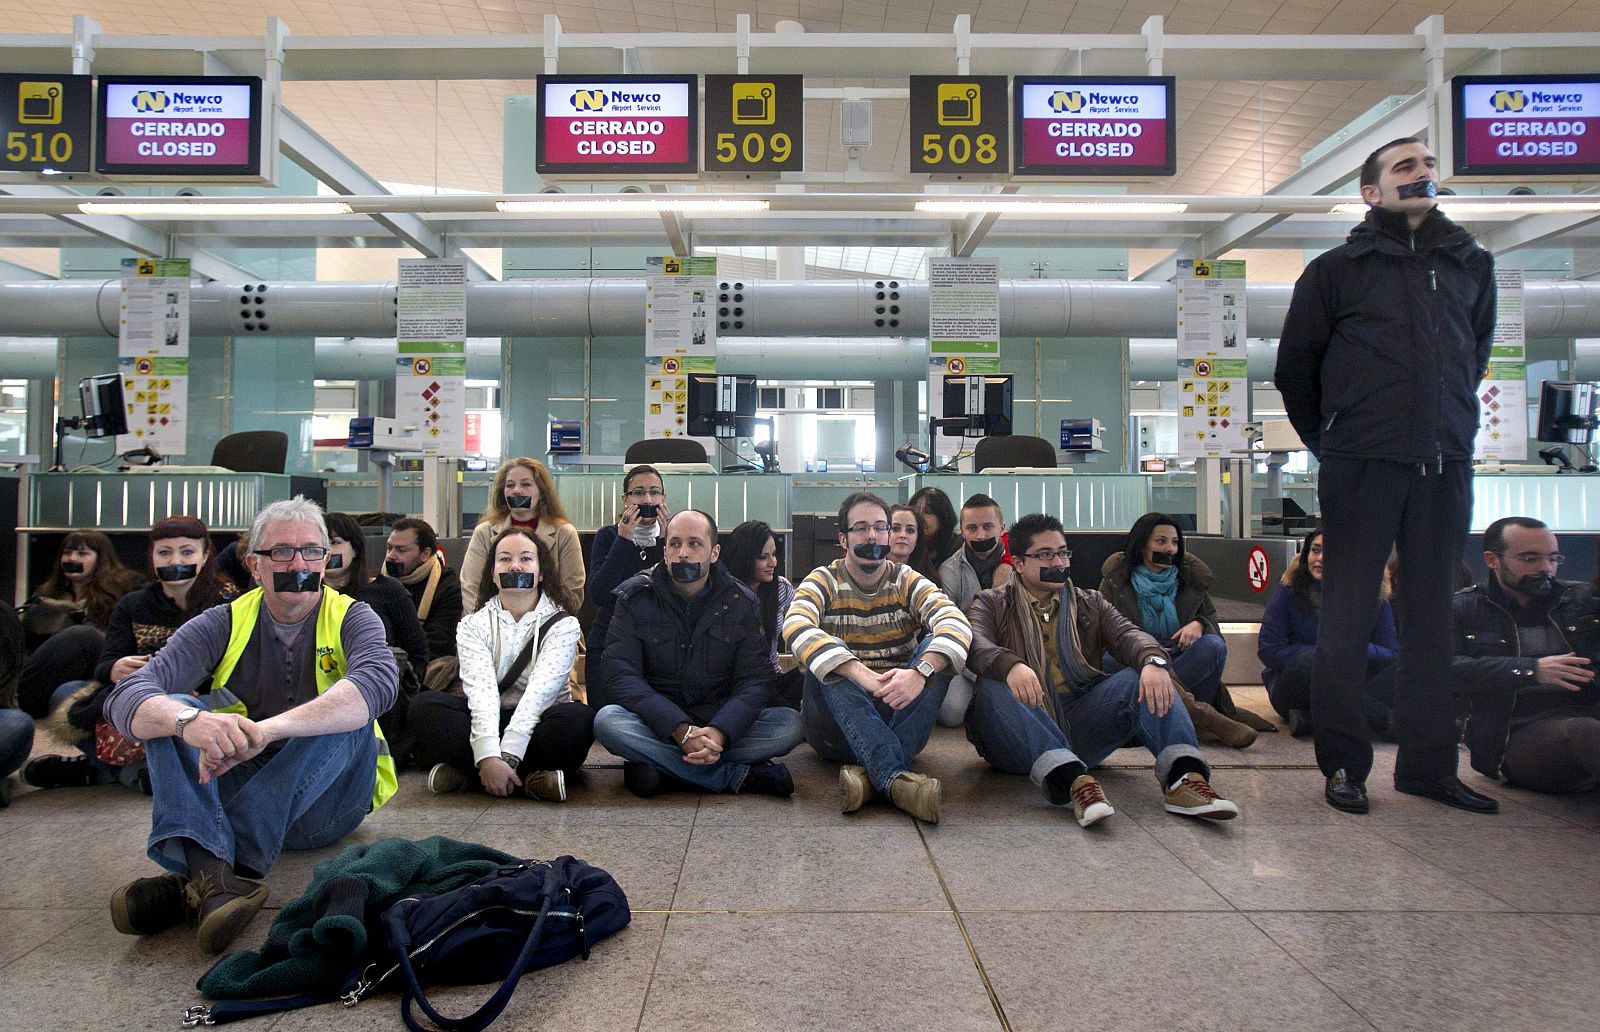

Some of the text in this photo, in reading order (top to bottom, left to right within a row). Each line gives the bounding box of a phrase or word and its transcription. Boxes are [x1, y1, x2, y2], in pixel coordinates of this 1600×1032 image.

[137, 91, 166, 112] N
[174, 93, 222, 104] Newco
[575, 90, 604, 111] N
[612, 91, 661, 102] Newco
[1053, 91, 1082, 112] N
[1089, 93, 1138, 104] Newco
[1495, 91, 1524, 112] N
[1532, 92, 1582, 103] Newco
[174, 106, 193, 114] Airport
[131, 122, 225, 137] CERRADO
[570, 121, 664, 135] CERRADO
[1048, 122, 1142, 137] CERRADO
[1490, 122, 1586, 136] CERRADO
[7, 131, 73, 163] 510
[138, 141, 217, 156] CLOSED
[577, 140, 656, 154] CLOSED
[716, 132, 792, 163] 509
[923, 133, 997, 164] 508
[1056, 142, 1134, 157] CLOSED
[1498, 141, 1578, 156] CLOSED
